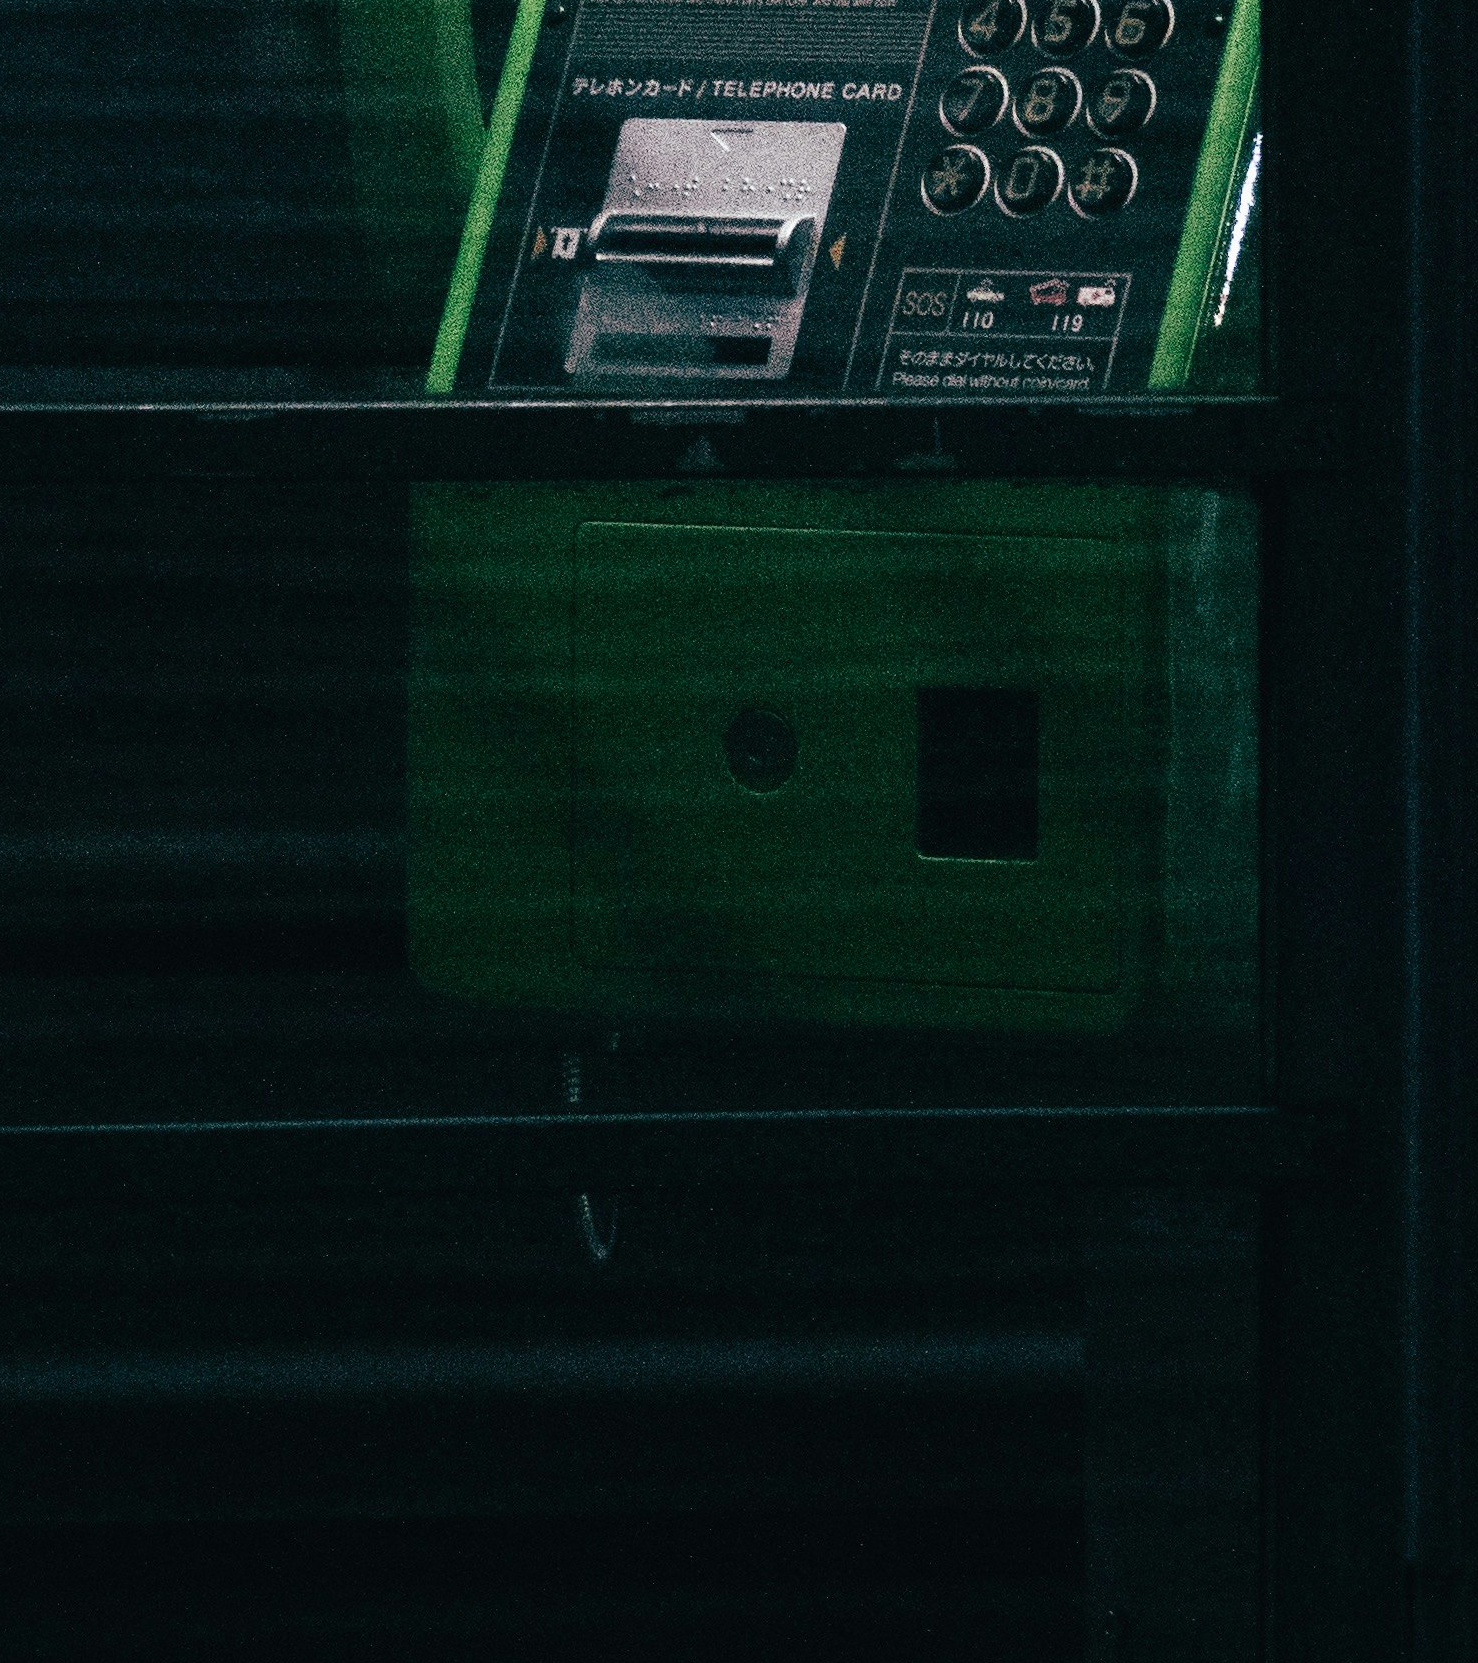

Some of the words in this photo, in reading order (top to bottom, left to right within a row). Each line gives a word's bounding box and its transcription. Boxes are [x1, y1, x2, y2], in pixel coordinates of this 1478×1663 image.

[969, 0, 1000, 42] 4
[1114, 1, 1150, 45] 6
[571, 77, 694, 97] テレホンカード
[712, 79, 835, 100] TELEPHONE
[842, 81, 903, 101] CARD
[958, 76, 985, 122] 7
[1024, 78, 1058, 123] 8
[1101, 79, 1132, 123] 9
[1005, 156, 1039, 200] 0
[902, 290, 947, 317] SOS
[961, 310, 995, 330] 110
[1051, 313, 1084, 333] 119
[892, 371, 939, 388] Please
[941, 373, 966, 388] dial
[968, 373, 1018, 390] without
